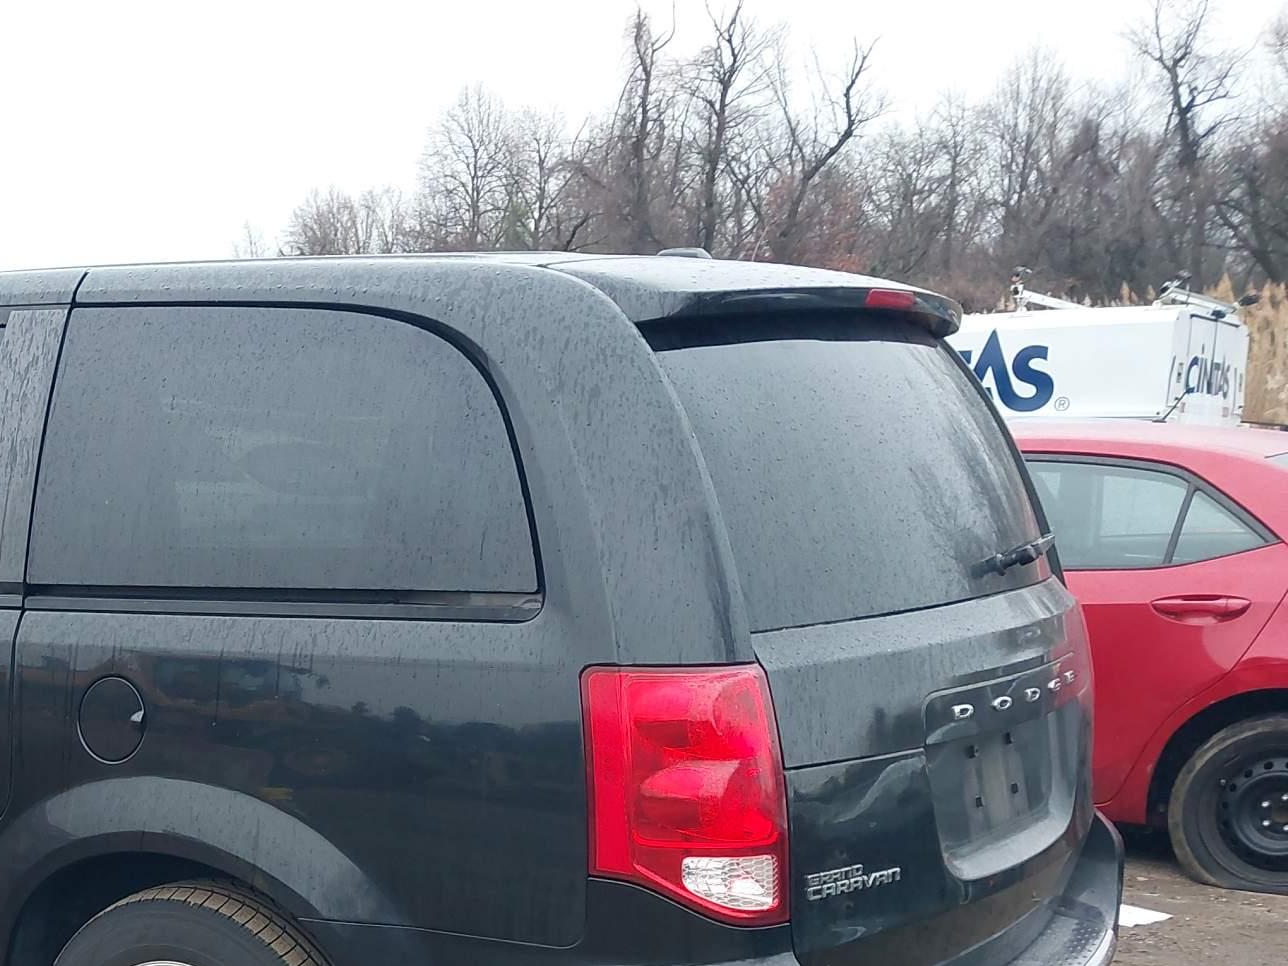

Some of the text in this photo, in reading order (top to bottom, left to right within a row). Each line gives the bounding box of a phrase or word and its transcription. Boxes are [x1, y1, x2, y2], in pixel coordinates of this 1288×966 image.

[958, 328, 1054, 412] AS
[951, 670, 1075, 720] DODGE
[805, 863, 864, 886] GRAND
[806, 867, 901, 902] CARAVAN
